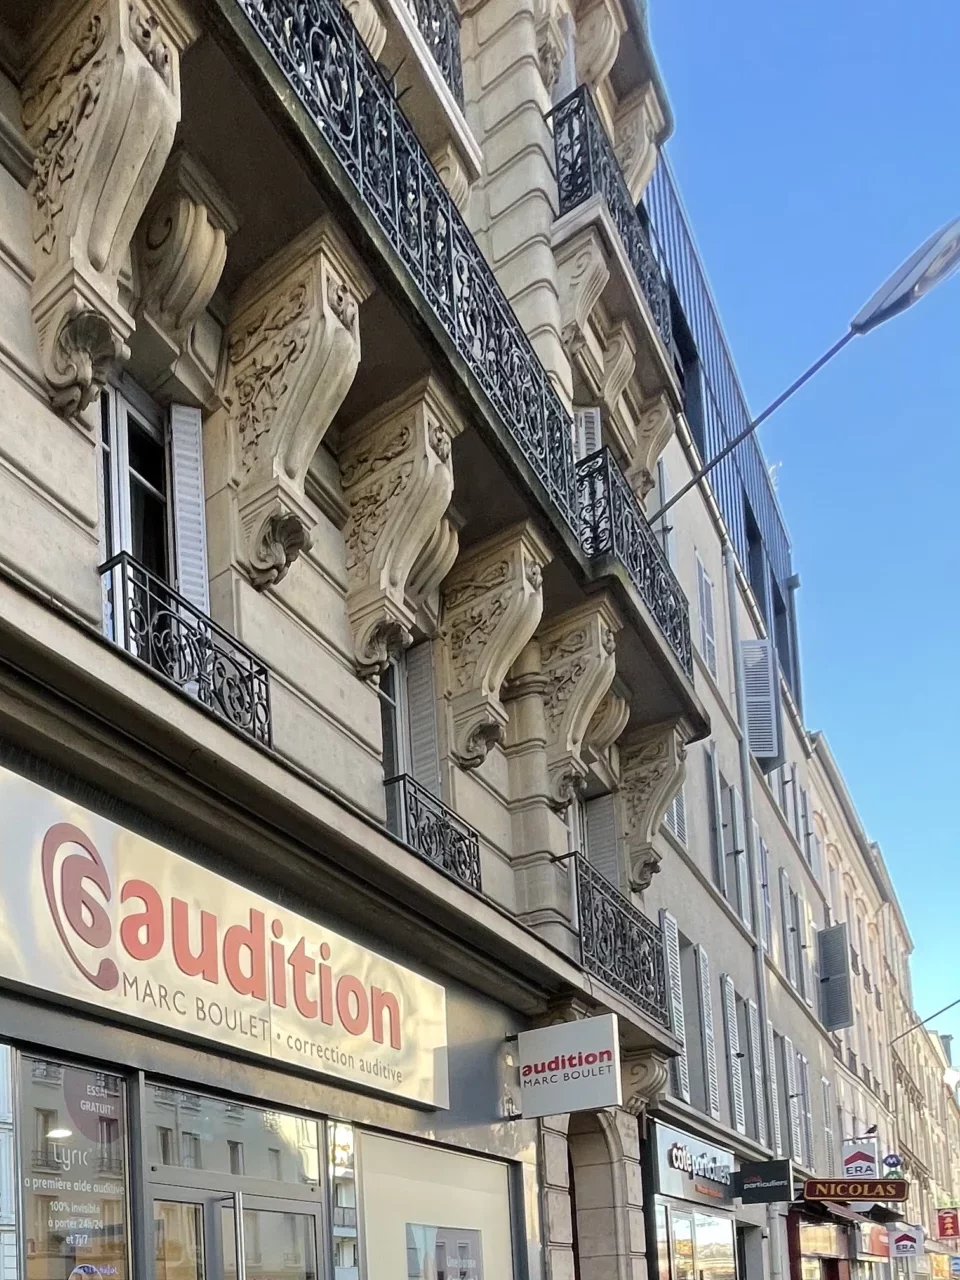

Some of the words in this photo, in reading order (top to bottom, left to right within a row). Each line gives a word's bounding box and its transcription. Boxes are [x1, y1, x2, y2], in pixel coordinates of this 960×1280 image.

[119, 879, 402, 1051] audition
[122, 971, 187, 1016] MARC
[196, 997, 270, 1042] BOULET
[286, 1032, 355, 1069] correction
[359, 1056, 403, 1084] auditive
[522, 1049, 612, 1077] audition
[523, 1074, 558, 1088] MARC
[563, 1065, 613, 1081] BOULET
[86, 1085, 108, 1098] ESSAI
[846, 1165, 874, 1175] ERA
[32, 1177, 71, 1191] première
[73, 1180, 92, 1192] aide
[93, 1182, 125, 1195] auditive
[743, 1180, 788, 1190] particuliers
[815, 1183, 897, 1196] NICOLAS
[49, 1200, 70, 1213] 100%
[71, 1202, 100, 1214] invisible
[895, 1243, 916, 1251] ERA
